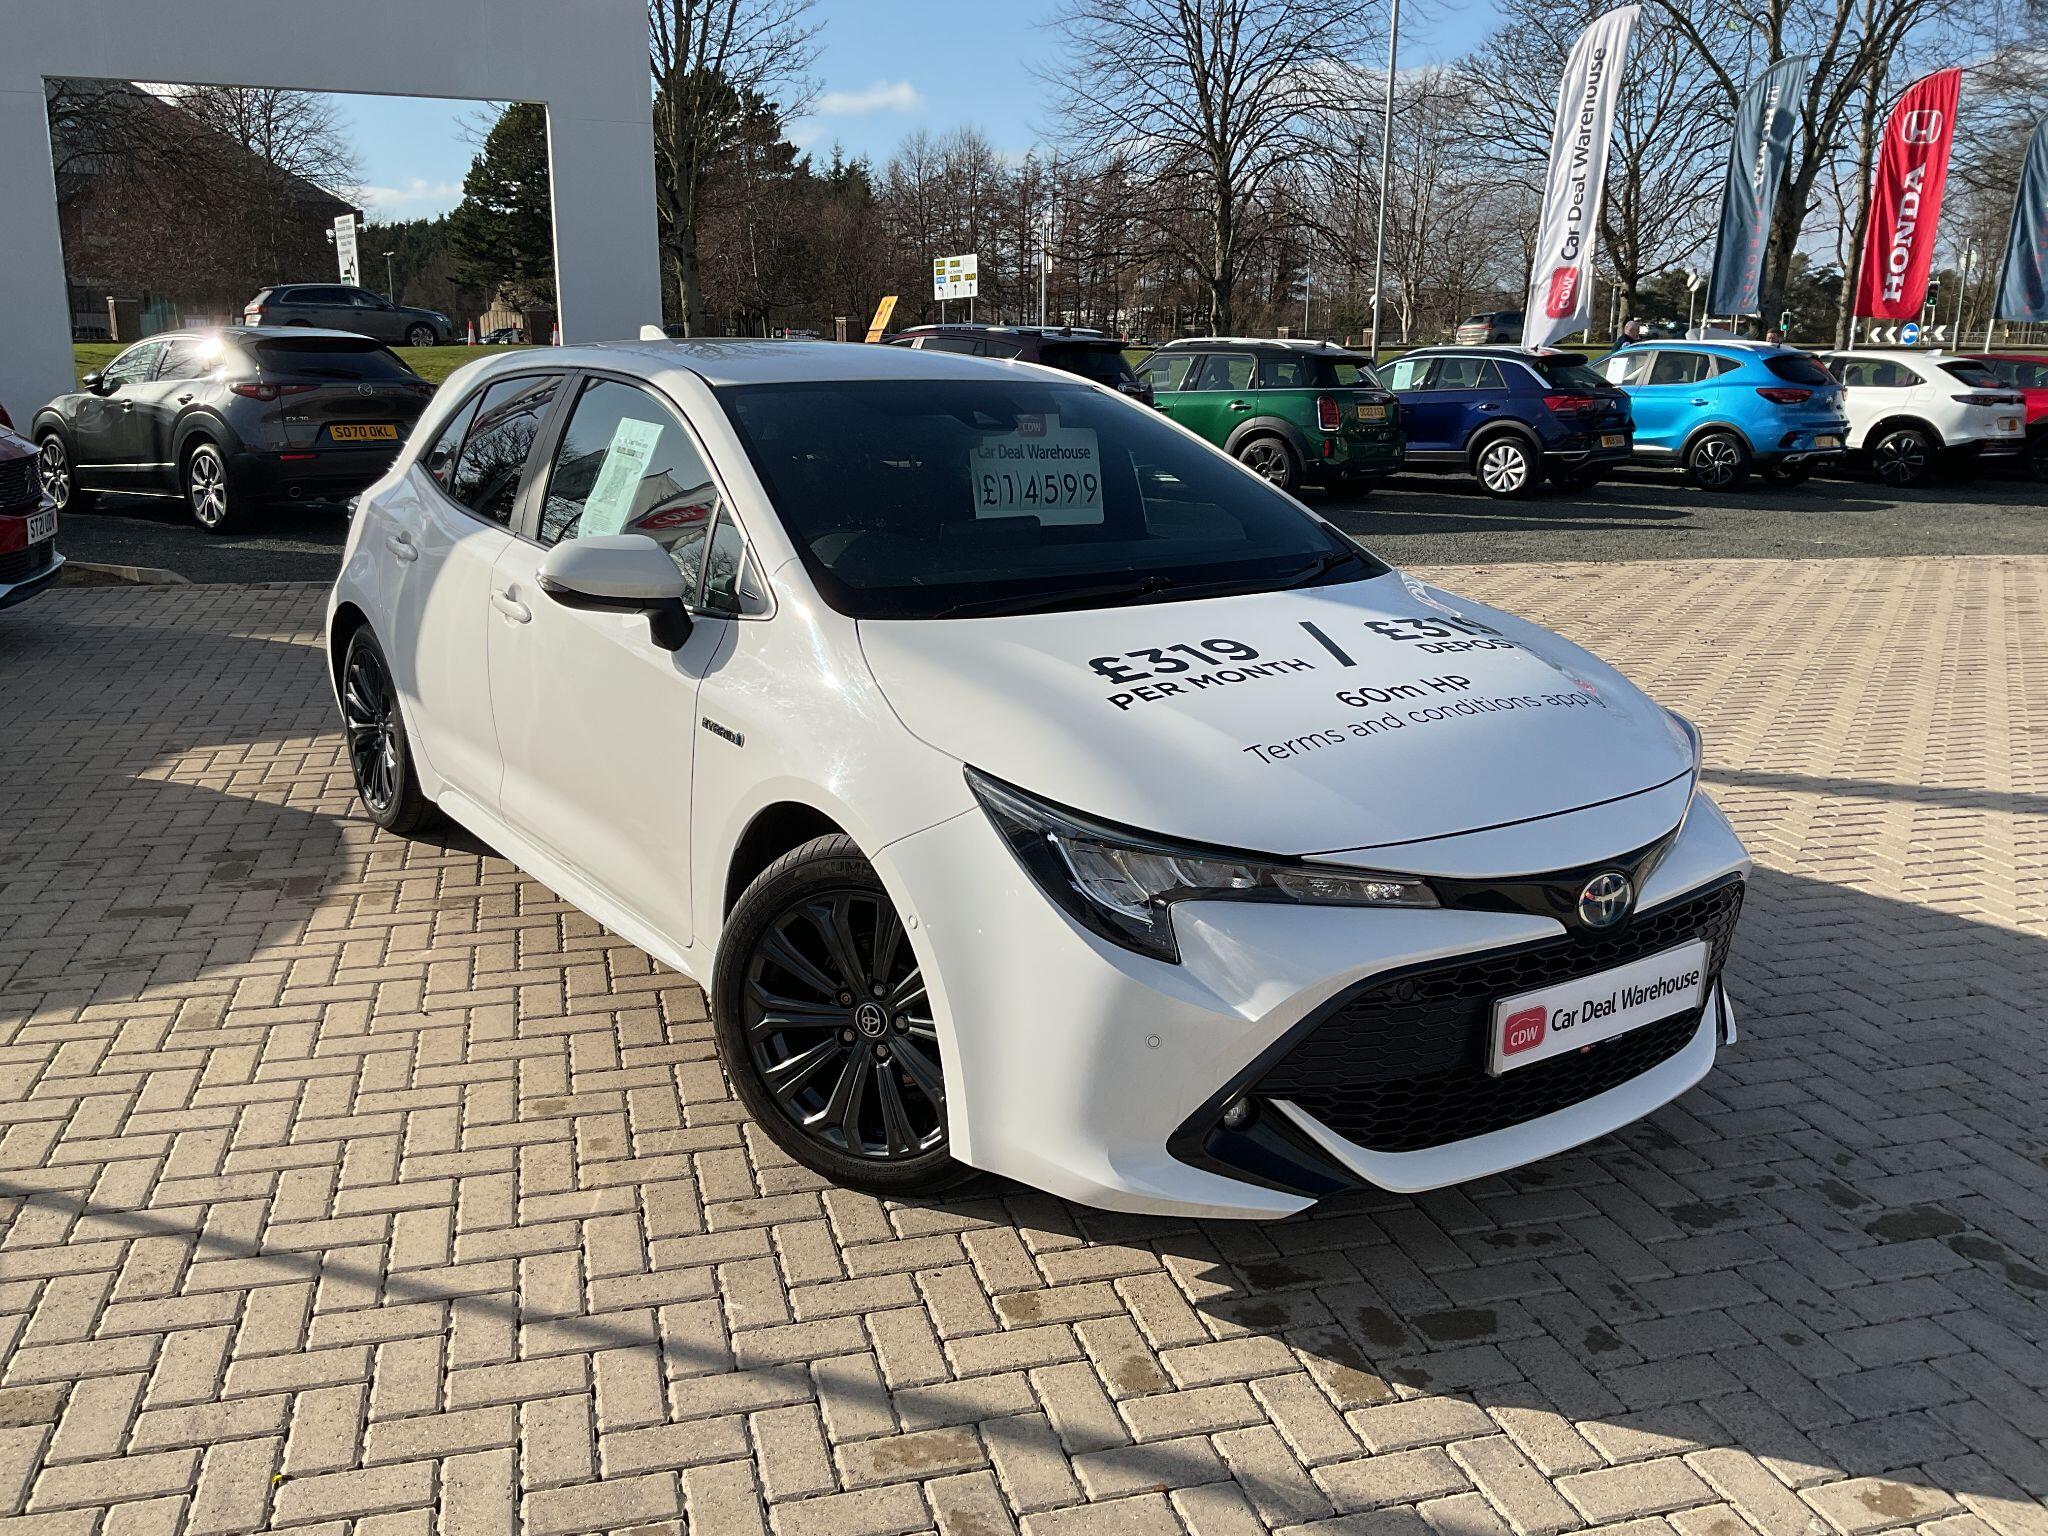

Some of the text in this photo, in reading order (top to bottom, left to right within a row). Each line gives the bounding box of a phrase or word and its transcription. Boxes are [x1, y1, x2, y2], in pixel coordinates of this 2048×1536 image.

[1561, 47, 1607, 261] Car Deal Warehouse
[1882, 162, 1926, 303] HONDA
[1558, 275, 1574, 309] CDW
[1022, 422, 1041, 432] CDW
[978, 443, 1091, 460] Car Deal Warehouse
[983, 473, 1098, 505] £14599
[1088, 638, 1260, 684] £319
[1106, 658, 1316, 711] PER MONTH
[1335, 675, 1472, 708] 60m HP
[1243, 690, 1607, 764] Terms and conditions apply
[1551, 969, 1700, 1032] Car Deal Warehouse
[1510, 1025, 1539, 1047] CDW
